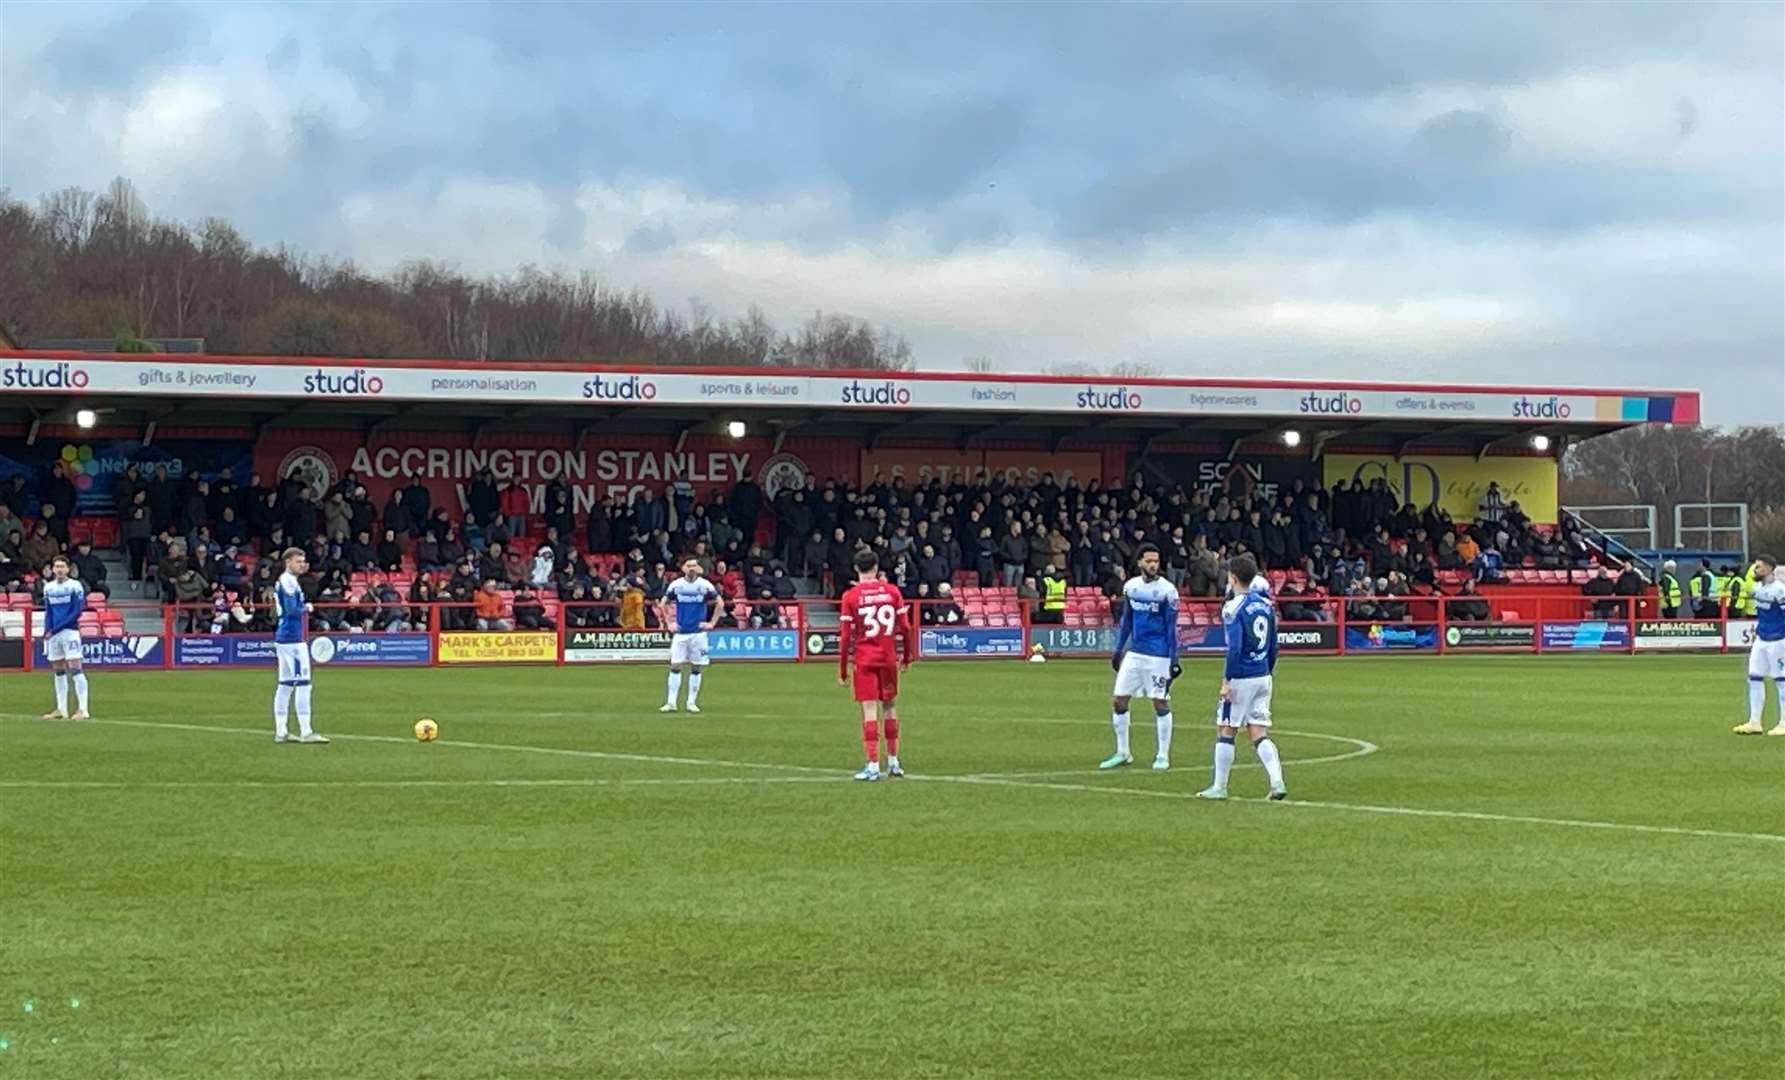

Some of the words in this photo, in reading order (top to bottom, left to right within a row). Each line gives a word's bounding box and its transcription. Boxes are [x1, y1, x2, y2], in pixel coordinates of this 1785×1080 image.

[3, 363, 89, 388] studio
[139, 370, 171, 386] gifts
[176, 370, 186, 384] &
[189, 370, 256, 388] jewellery
[304, 369, 384, 394] studio
[432, 377, 537, 392] personalisation
[583, 375, 657, 400] studio
[700, 383, 741, 396] sports
[744, 382, 754, 395] &
[757, 383, 799, 396] leisure
[841, 380, 911, 405] studio
[972, 386, 1016, 401] fashion
[1077, 385, 1142, 409] studio
[1300, 392, 1362, 414] studio
[1512, 397, 1571, 418] studio
[351, 446, 585, 481] ACCRINGTON
[596, 451, 750, 482] STANLEY
[858, 604, 895, 638] 39
[440, 636, 492, 649] MARK'S
[494, 635, 556, 648] CARPETS
[1048, 629, 1097, 647] 1838
[1252, 615, 1269, 650] 9
[337, 640, 377, 653] Pierce
